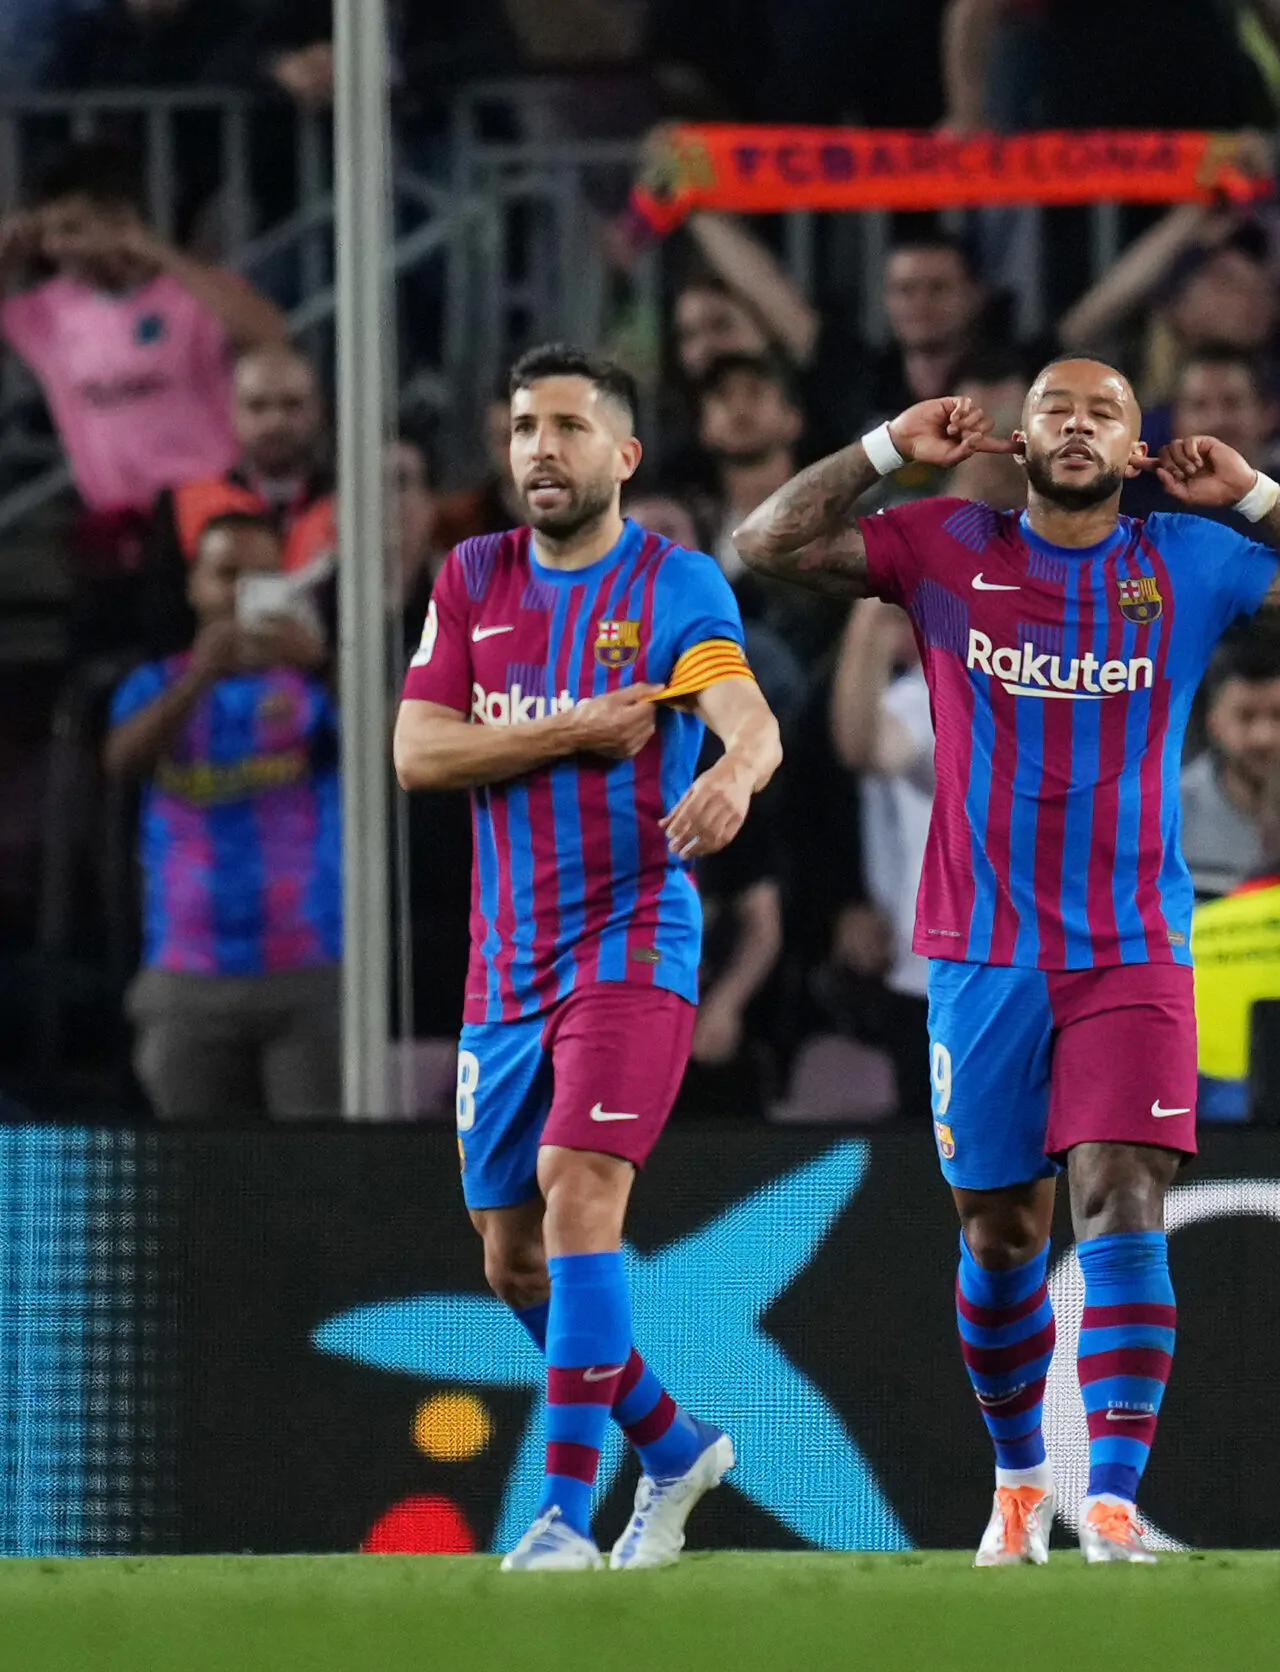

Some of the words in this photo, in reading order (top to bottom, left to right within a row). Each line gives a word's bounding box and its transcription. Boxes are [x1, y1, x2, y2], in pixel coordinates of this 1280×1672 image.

[967, 628, 1153, 693] Rakuten
[472, 682, 592, 727] Rakut
[932, 1042, 952, 1116] 9
